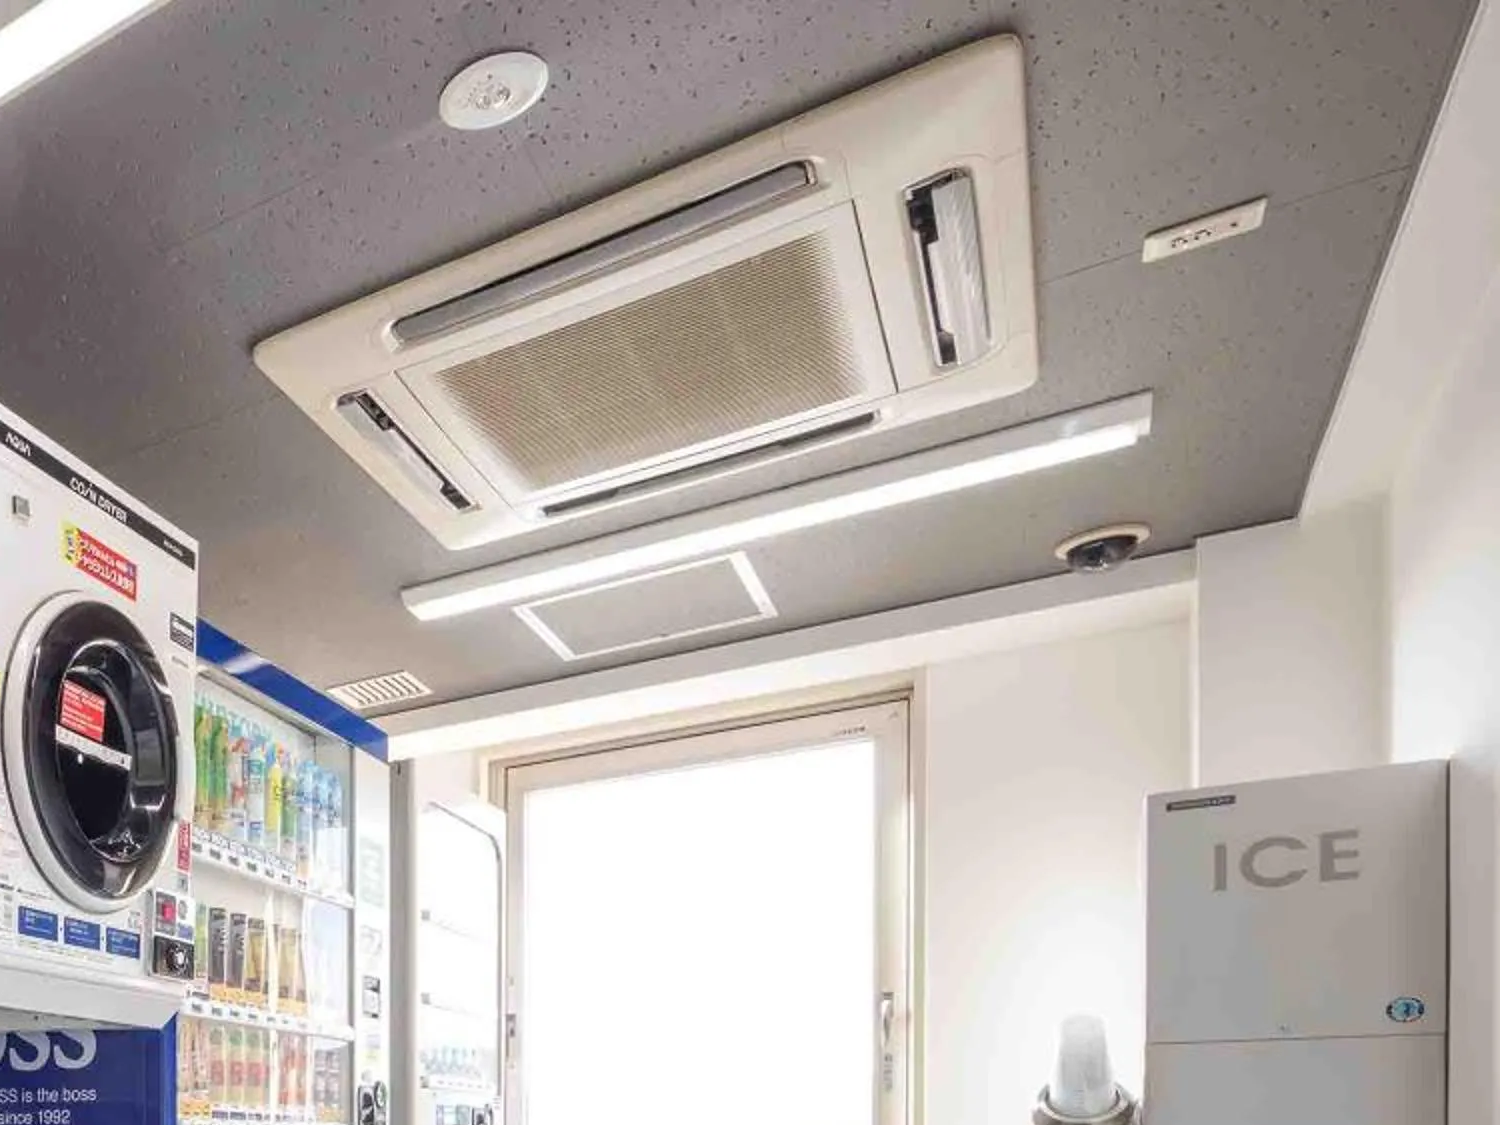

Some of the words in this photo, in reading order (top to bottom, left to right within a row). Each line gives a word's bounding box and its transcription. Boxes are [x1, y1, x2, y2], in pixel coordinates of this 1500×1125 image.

[1213, 828, 1360, 892] ICE
[21, 1087, 32, 1102] is
[37, 1087, 58, 1102] the
[63, 1087, 97, 1102] boss
[37, 1109, 71, 1125] 1992
